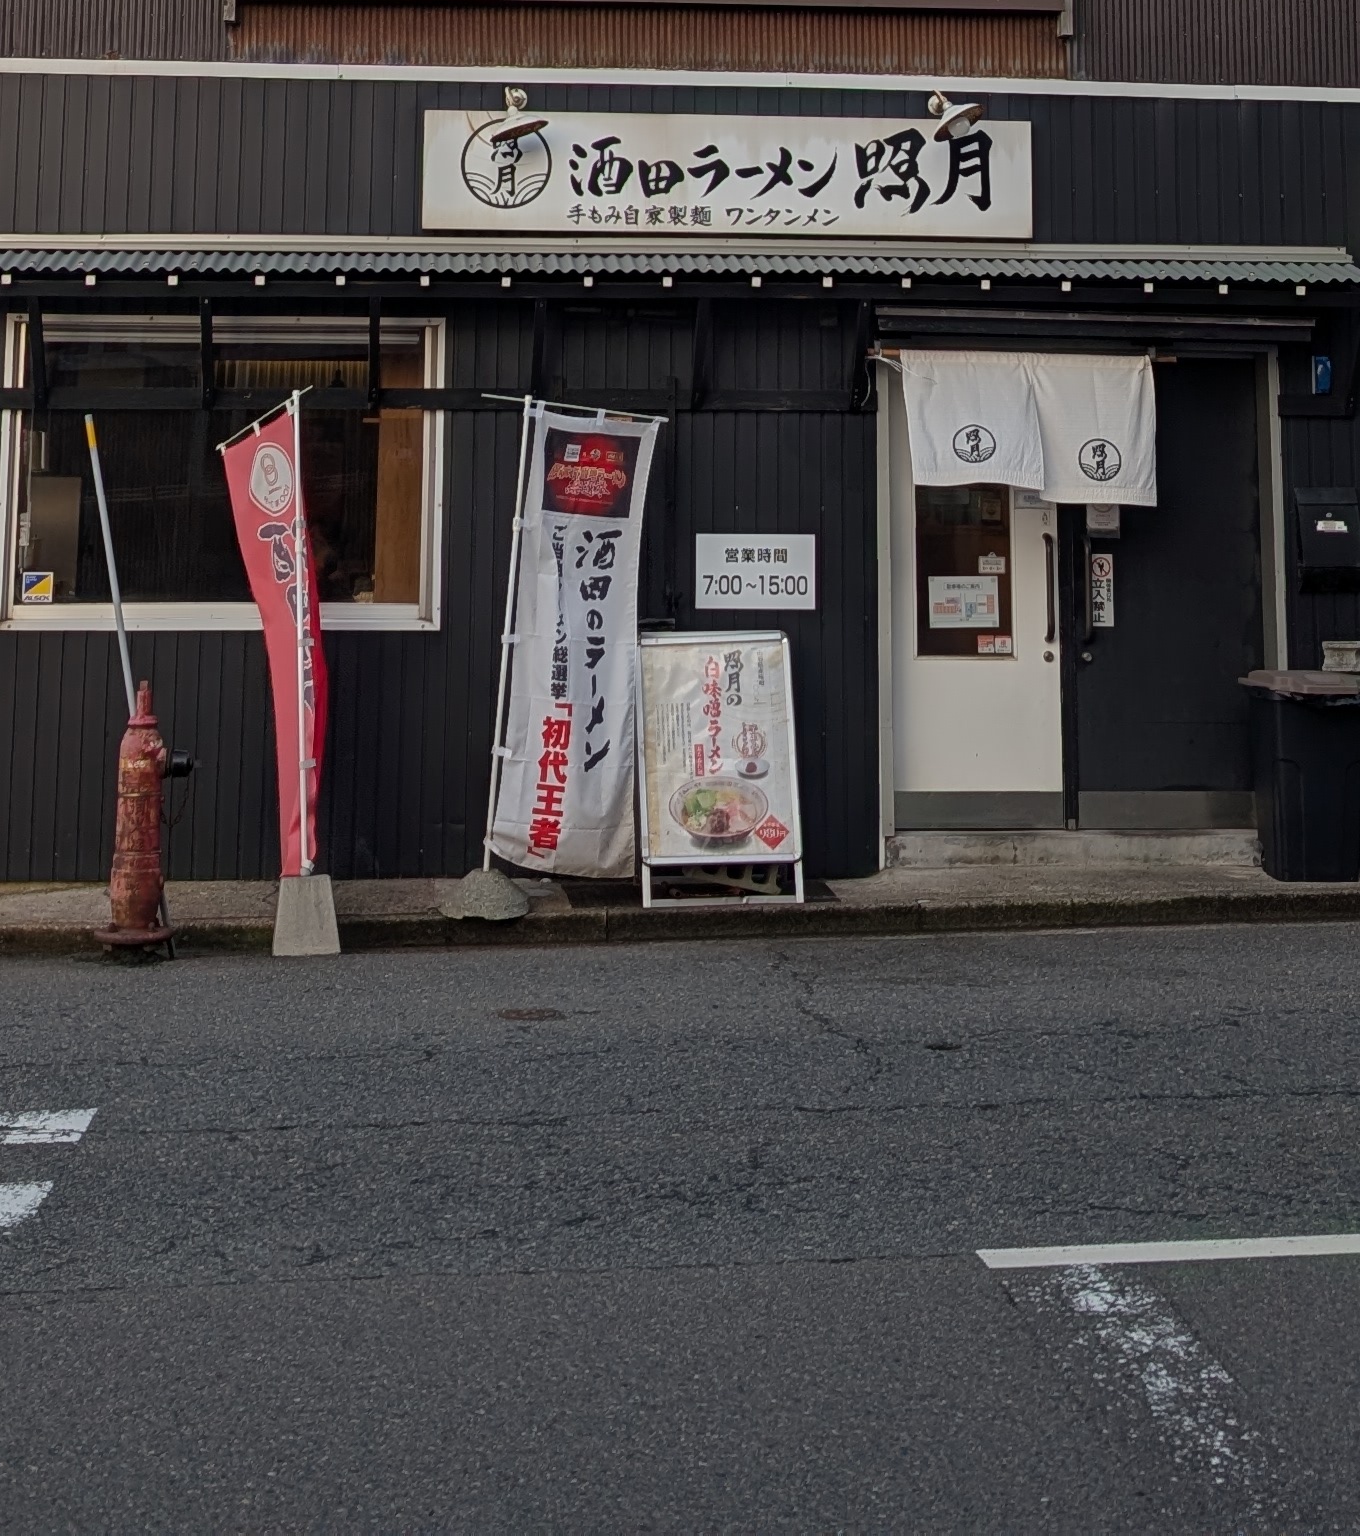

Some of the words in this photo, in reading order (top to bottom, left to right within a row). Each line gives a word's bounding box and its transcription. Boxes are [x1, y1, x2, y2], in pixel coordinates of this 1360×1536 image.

[569, 135, 839, 200] 酒田ラーメン
[853, 127, 994, 217] 照月
[566, 205, 713, 227] 手もみ自家製麺
[725, 206, 841, 228] ワンタンメン
[724, 547, 788, 564] 営業時間
[1092, 577, 1106, 624] 立入禁止
[575, 528, 623, 774] 酒田のラーメン
[724, 649, 744, 707] 照月の
[702, 655, 724, 775] 白味噌ラーメン
[526, 701, 573, 860] 「初代王者」
